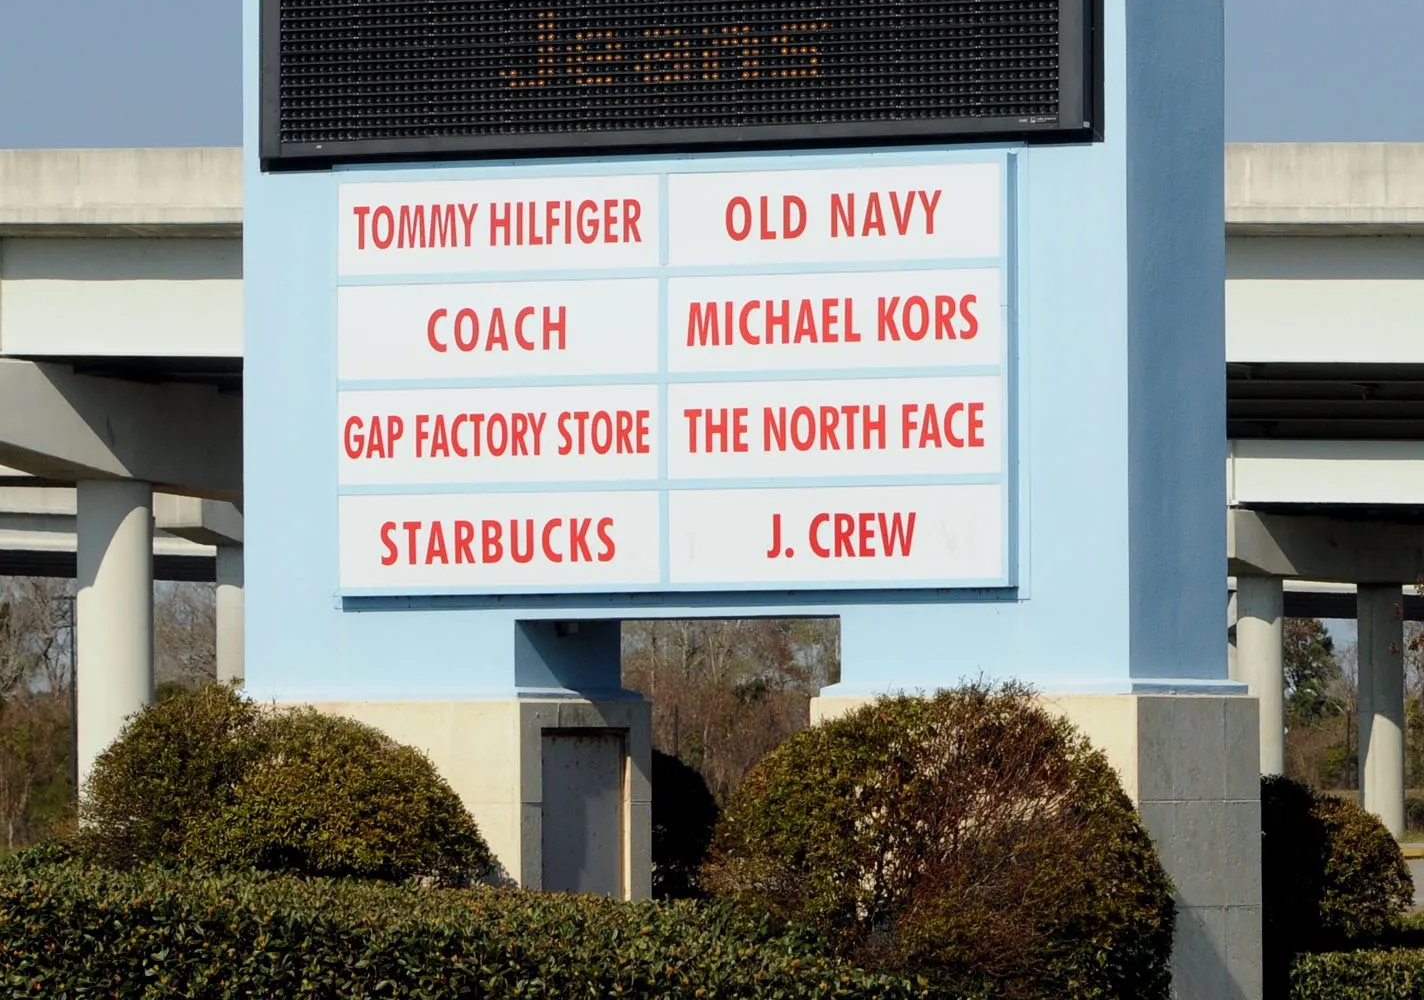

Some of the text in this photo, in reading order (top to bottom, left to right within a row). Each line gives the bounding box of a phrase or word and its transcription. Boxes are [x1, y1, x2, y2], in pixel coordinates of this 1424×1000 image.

[499, 10, 829, 87] Jeans
[353, 198, 642, 250] TOMMY HILFIGER
[724, 189, 943, 242] OLD NAVY
[426, 305, 567, 353] COACH
[686, 293, 980, 347] MICHAEL KORS
[343, 409, 651, 460] GAP FACTORY STORE
[683, 401, 986, 454] THE NORTH FACE
[379, 516, 617, 567] STARBUCKS
[766, 511, 918, 559] J. CREW
